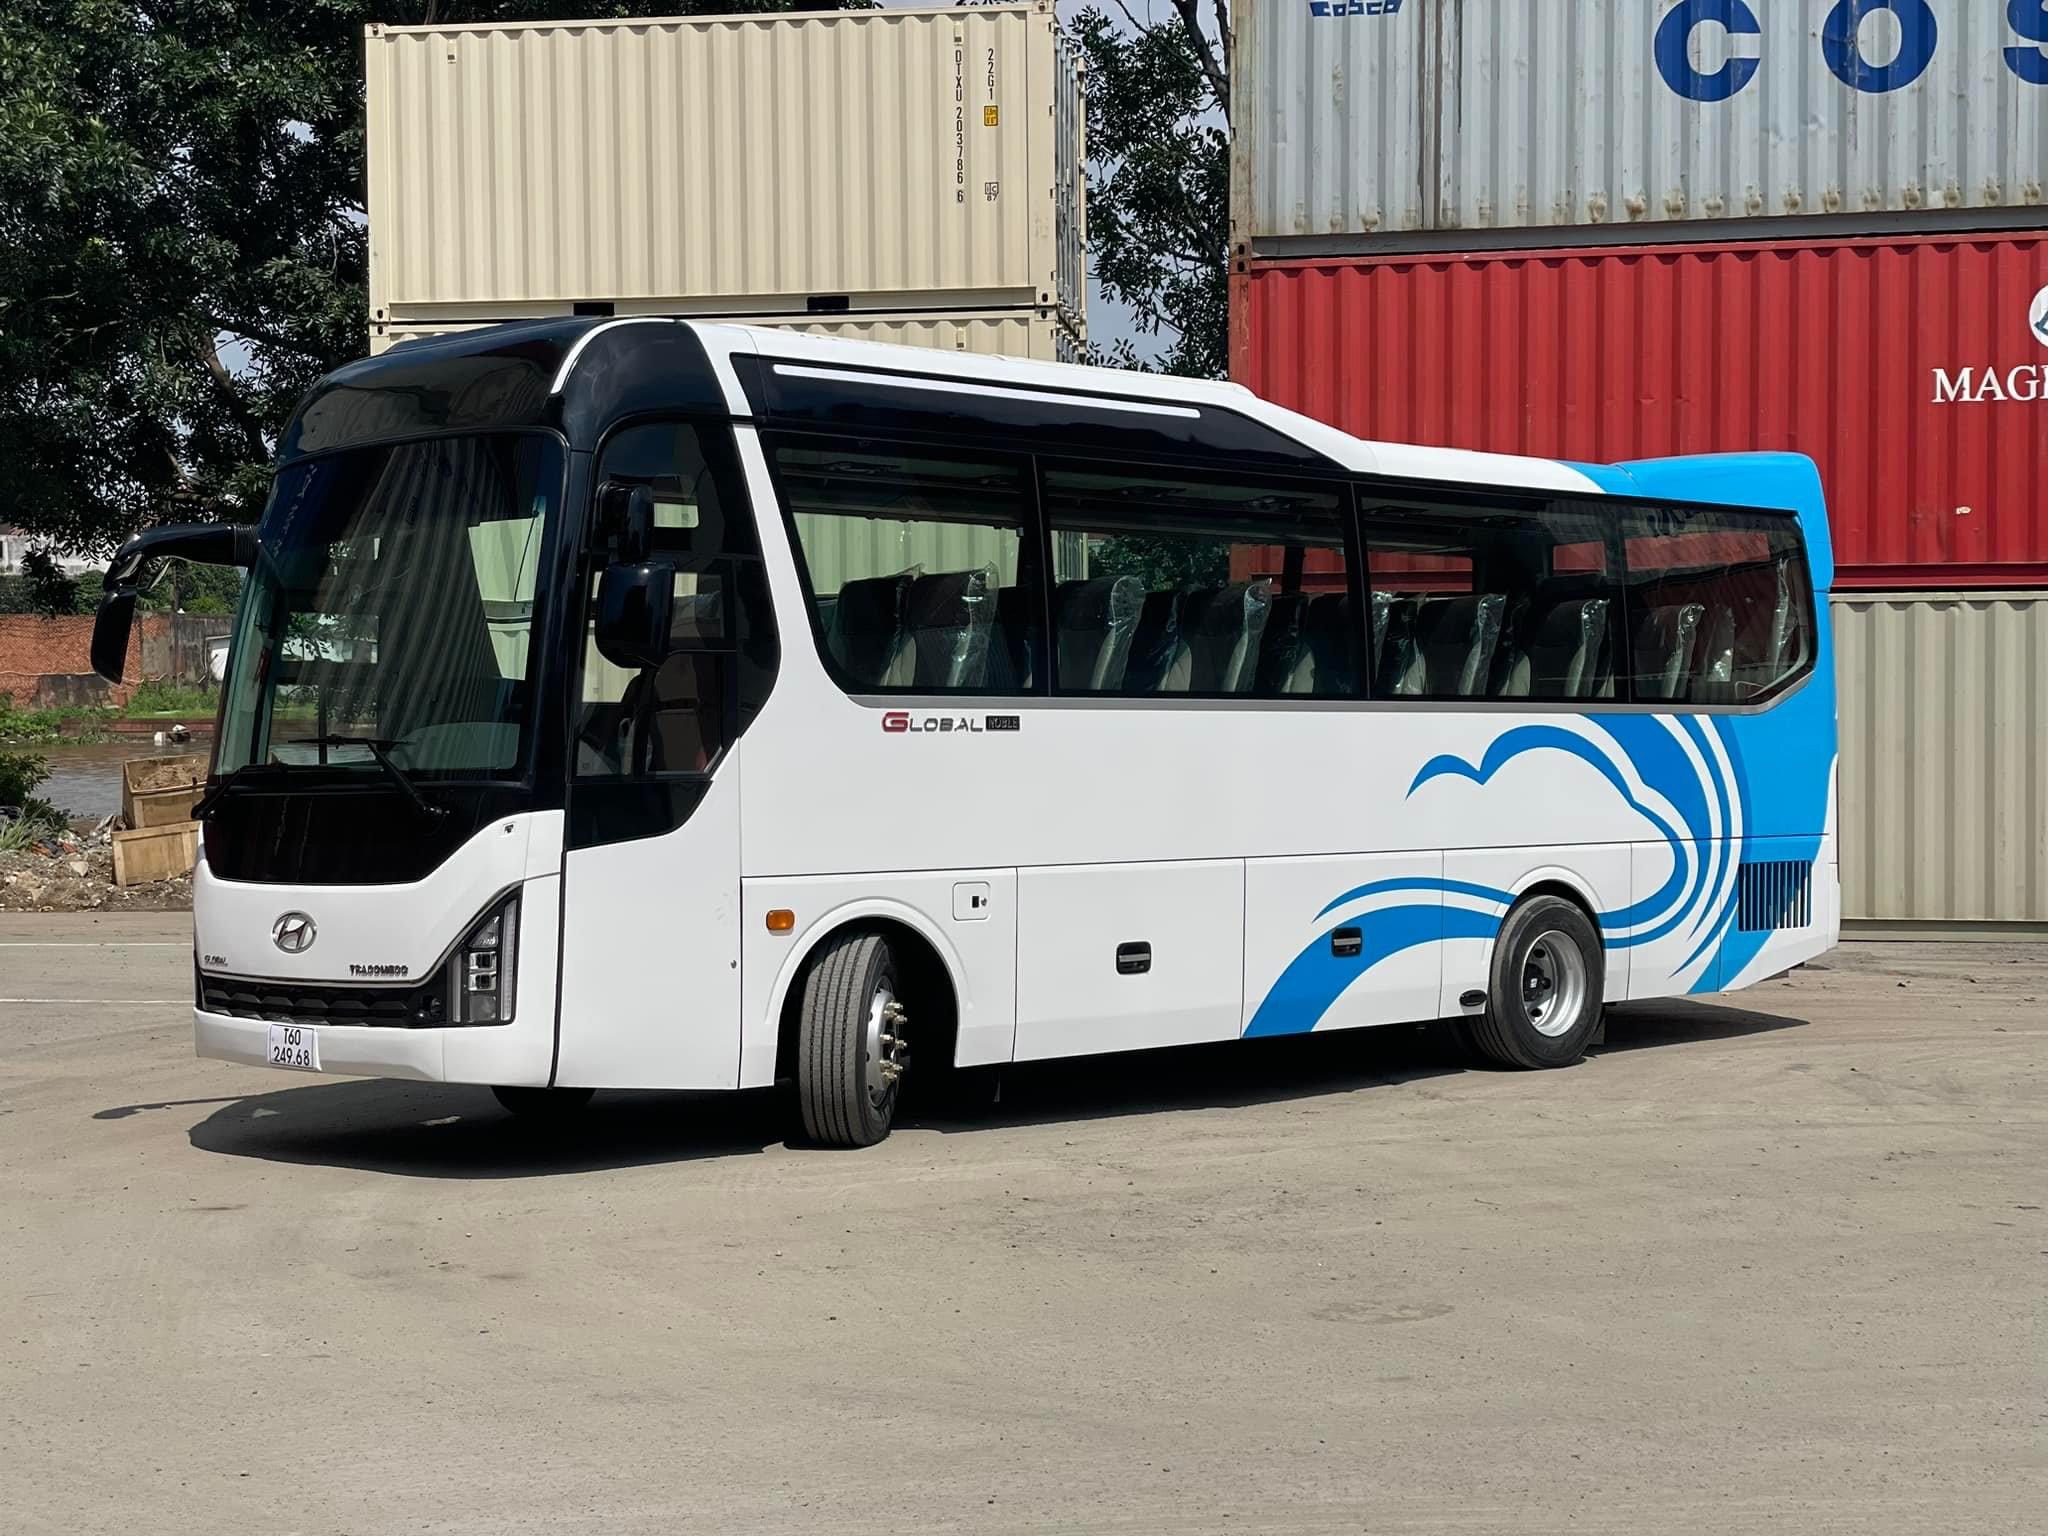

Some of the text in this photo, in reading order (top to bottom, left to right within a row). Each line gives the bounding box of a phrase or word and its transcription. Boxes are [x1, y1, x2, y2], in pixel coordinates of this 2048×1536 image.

[1309, 0, 1403, 17] COSCO
[987, 48, 995, 100] 22G1
[955, 49, 965, 203] DTXU 203786 6
[284, 1028, 301, 1046] T60
[273, 1046, 310, 1066] 249.68
